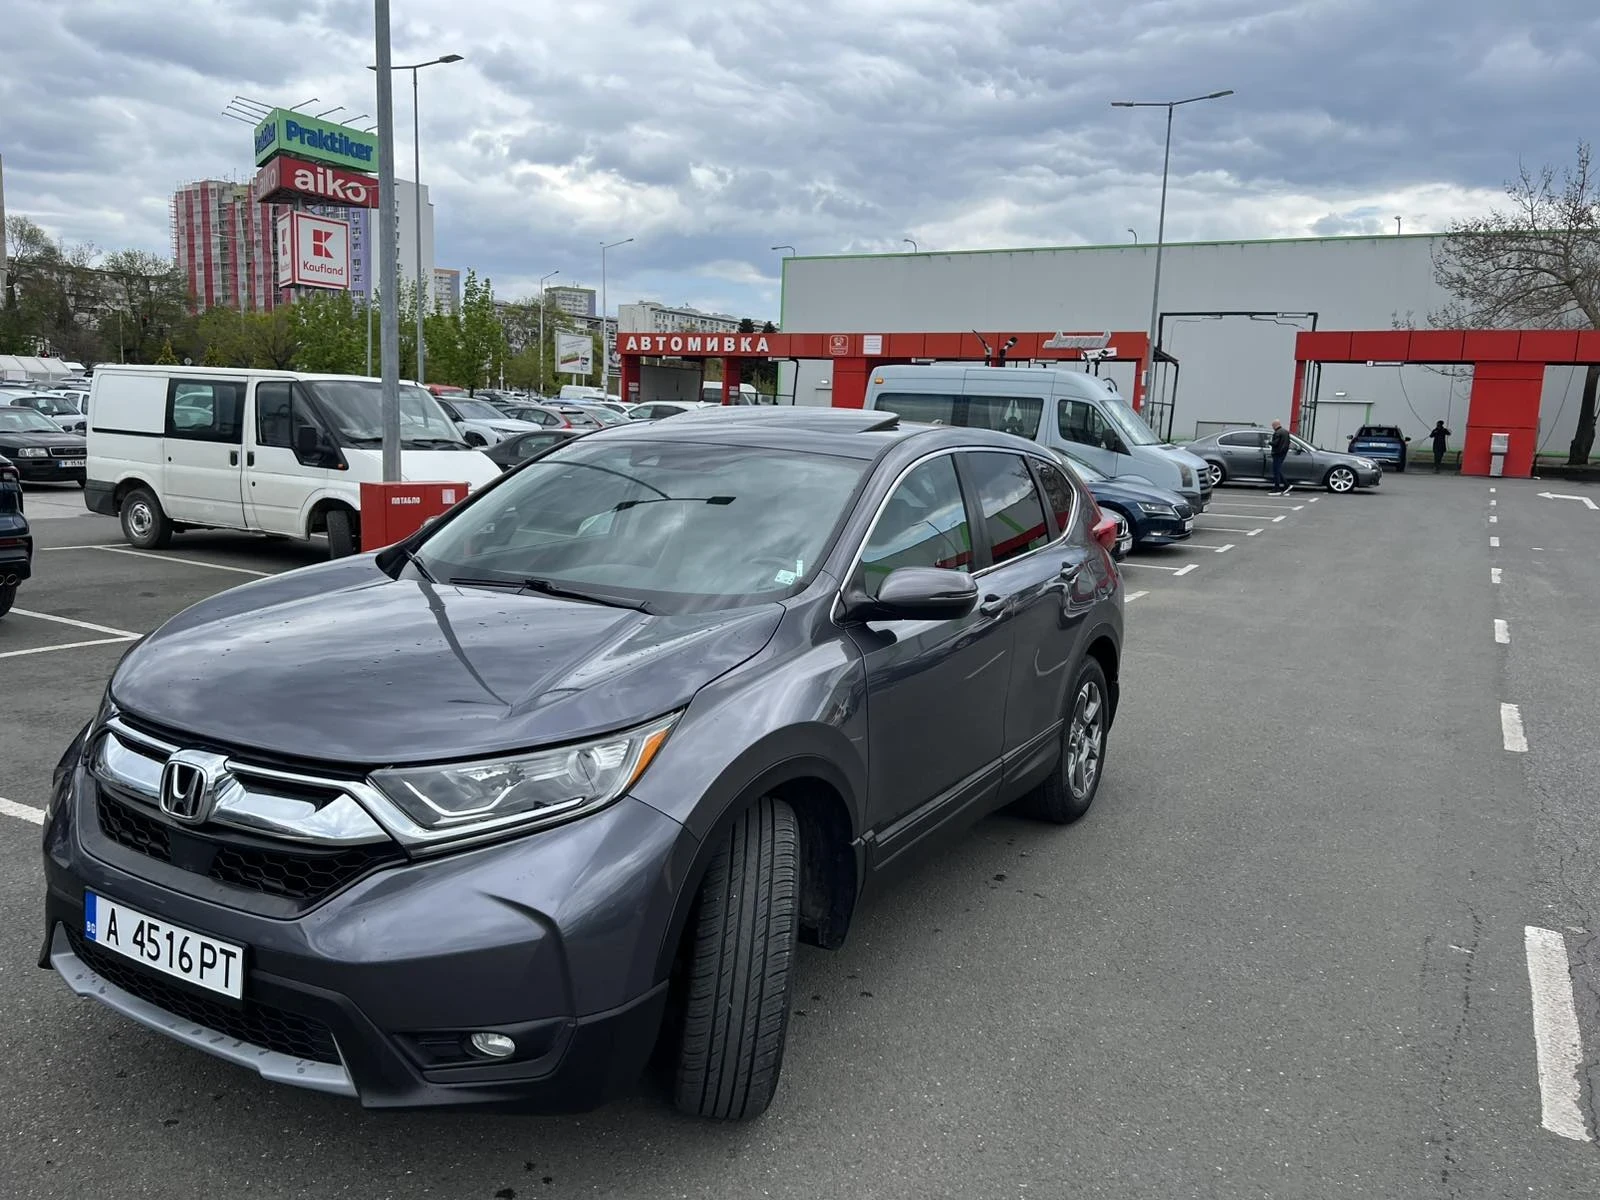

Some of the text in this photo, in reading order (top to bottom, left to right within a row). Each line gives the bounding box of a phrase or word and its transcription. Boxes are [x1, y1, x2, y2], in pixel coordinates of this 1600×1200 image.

[286, 119, 373, 161] Praktiker
[294, 167, 367, 202] aiko
[303, 261, 344, 276] Kaufland
[626, 336, 769, 352] АВТОМИВКА
[86, 921, 96, 934] BG
[106, 908, 120, 946] A
